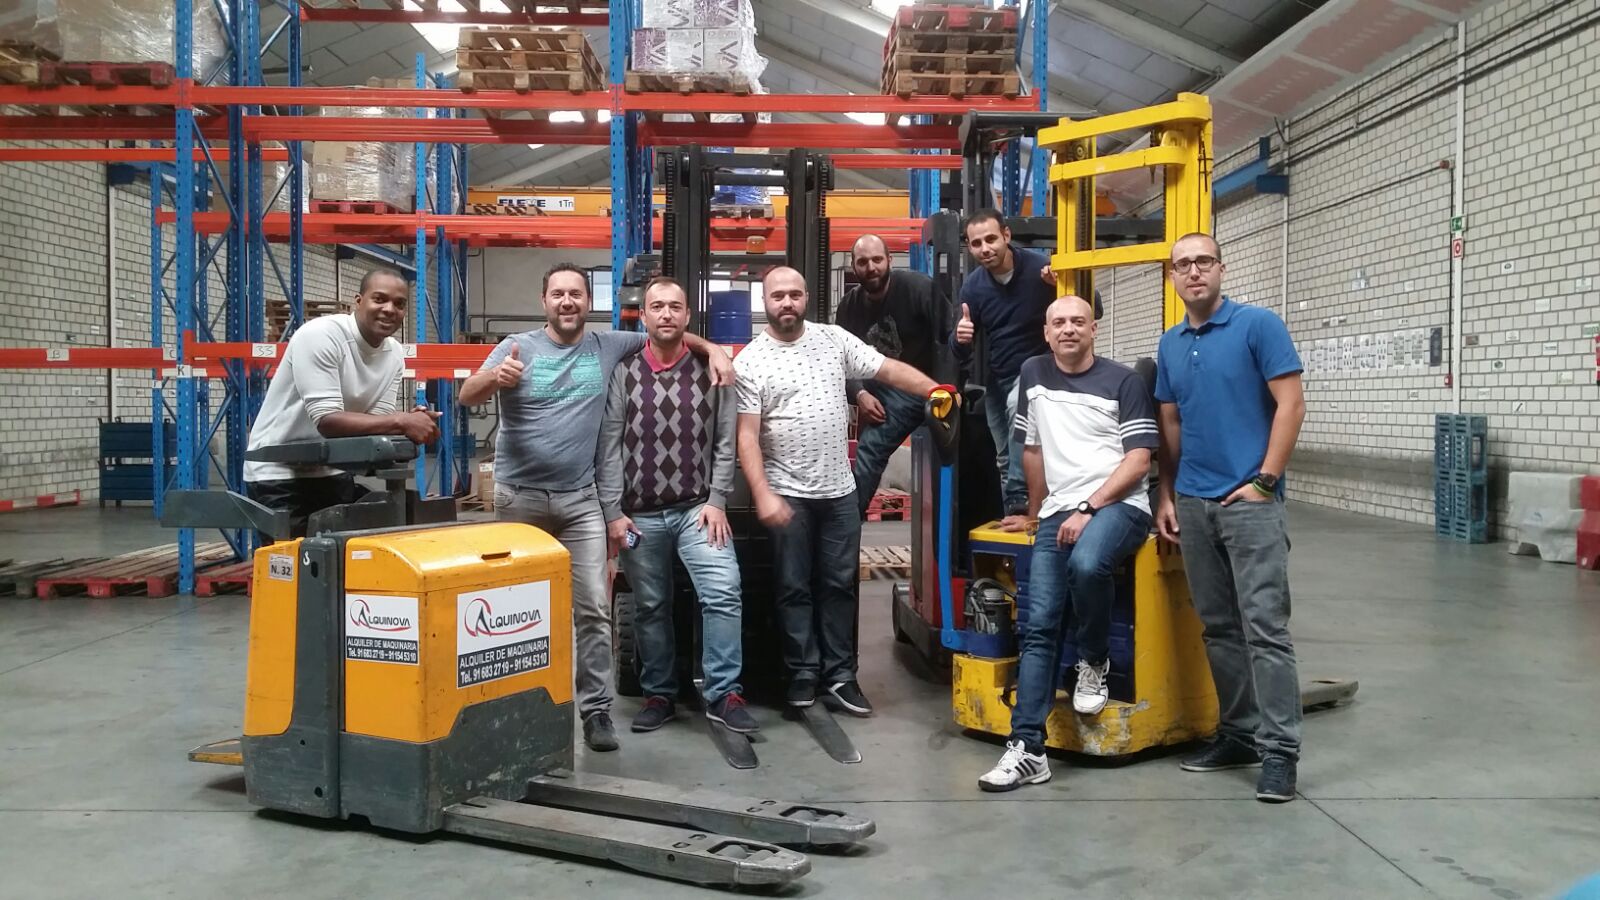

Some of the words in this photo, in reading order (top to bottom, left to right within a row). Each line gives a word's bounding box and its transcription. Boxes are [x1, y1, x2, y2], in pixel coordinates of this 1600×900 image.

[255, 345, 273, 356] 33
[177, 366, 185, 376] K
[281, 566, 291, 576] 32
[357, 605, 411, 629] ALQUINOVA
[474, 605, 542, 637] ALQUINOVA
[348, 638, 374, 648] ALQUILER
[374, 639, 382, 648] DE
[382, 641, 417, 651] MAQUINARIA
[357, 648, 363, 657] 91
[363, 648, 373, 658] 683
[372, 649, 379, 659] 27
[378, 650, 385, 659] 19
[388, 651, 395, 660] 91
[394, 650, 404, 661] 154
[404, 651, 411, 661] 53
[410, 652, 417, 662] 10
[460, 651, 495, 669] ALQUILER
[496, 648, 506, 660] DE
[507, 639, 548, 658] MAQUINARIA
[460, 670, 472, 685] Tel.
[473, 668, 480, 681] 91
[481, 665, 493, 679] 683
[493, 662, 501, 676] 27
[502, 661, 509, 674] 19
[514, 658, 521, 671] 91
[521, 655, 532, 669] 154
[532, 653, 540, 666] 53
[540, 652, 547, 664] 10
